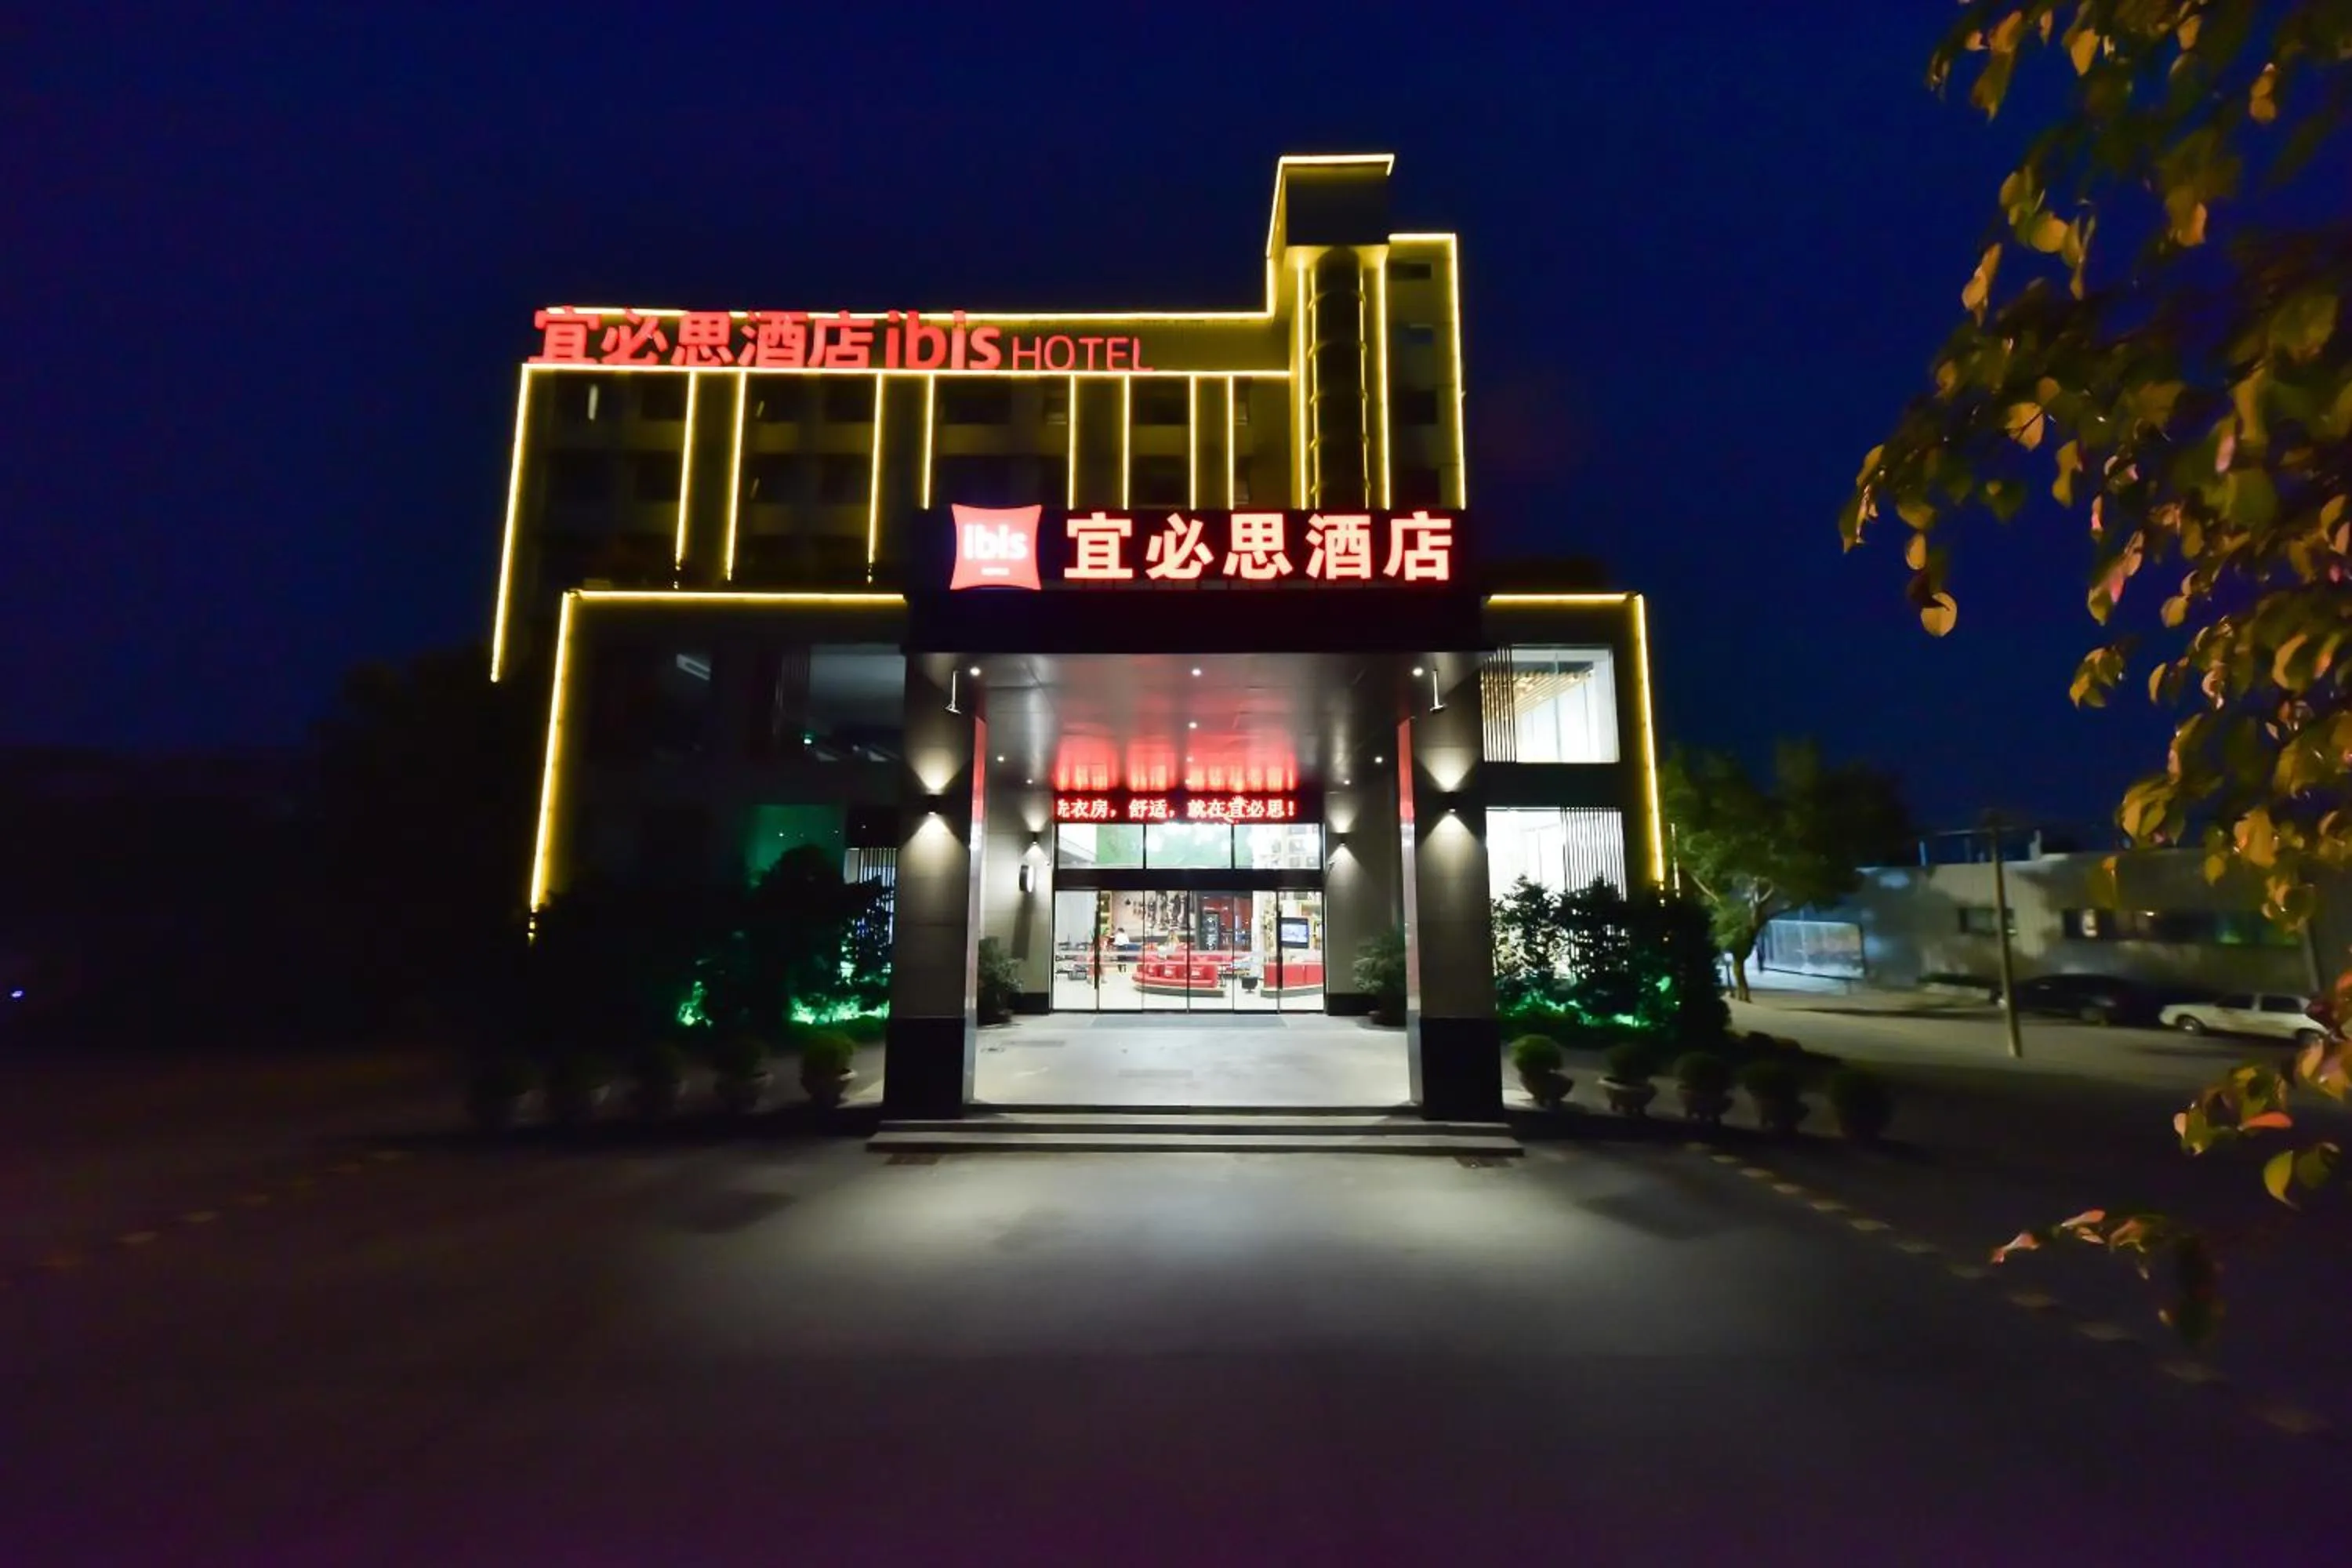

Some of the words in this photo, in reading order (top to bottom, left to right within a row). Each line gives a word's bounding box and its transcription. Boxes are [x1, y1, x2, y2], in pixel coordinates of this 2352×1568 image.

[526, 305, 875, 367] 宜必思酒店
[884, 310, 1001, 370] ibis
[1011, 335, 1155, 372] HOTEL
[964, 523, 1029, 561] ibis
[1064, 512, 1453, 581] 宜必思酒店
